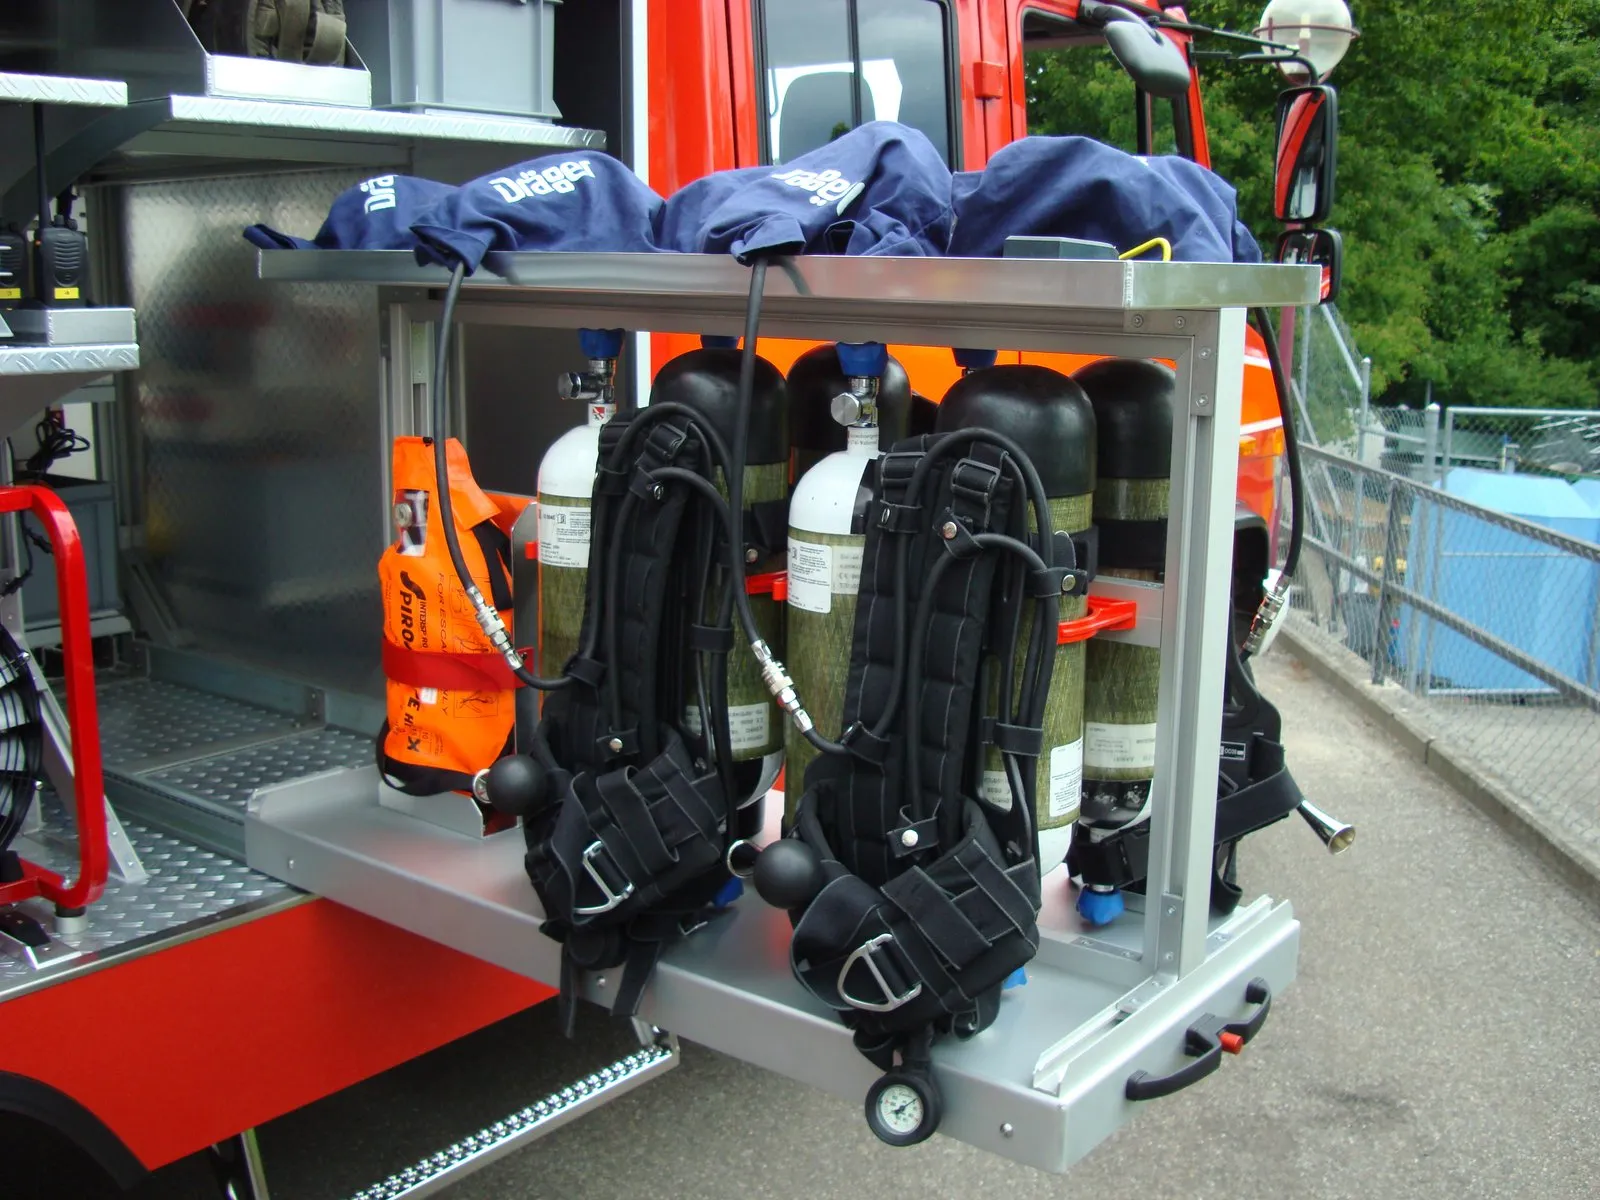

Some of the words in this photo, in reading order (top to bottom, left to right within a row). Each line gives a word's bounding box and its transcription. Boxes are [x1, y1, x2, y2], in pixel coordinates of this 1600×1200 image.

[360, 174, 399, 215] Drä
[488, 160, 596, 204] Dräger
[437, 572, 445, 605] FOR
[419, 601, 429, 649] INTERSPRO
